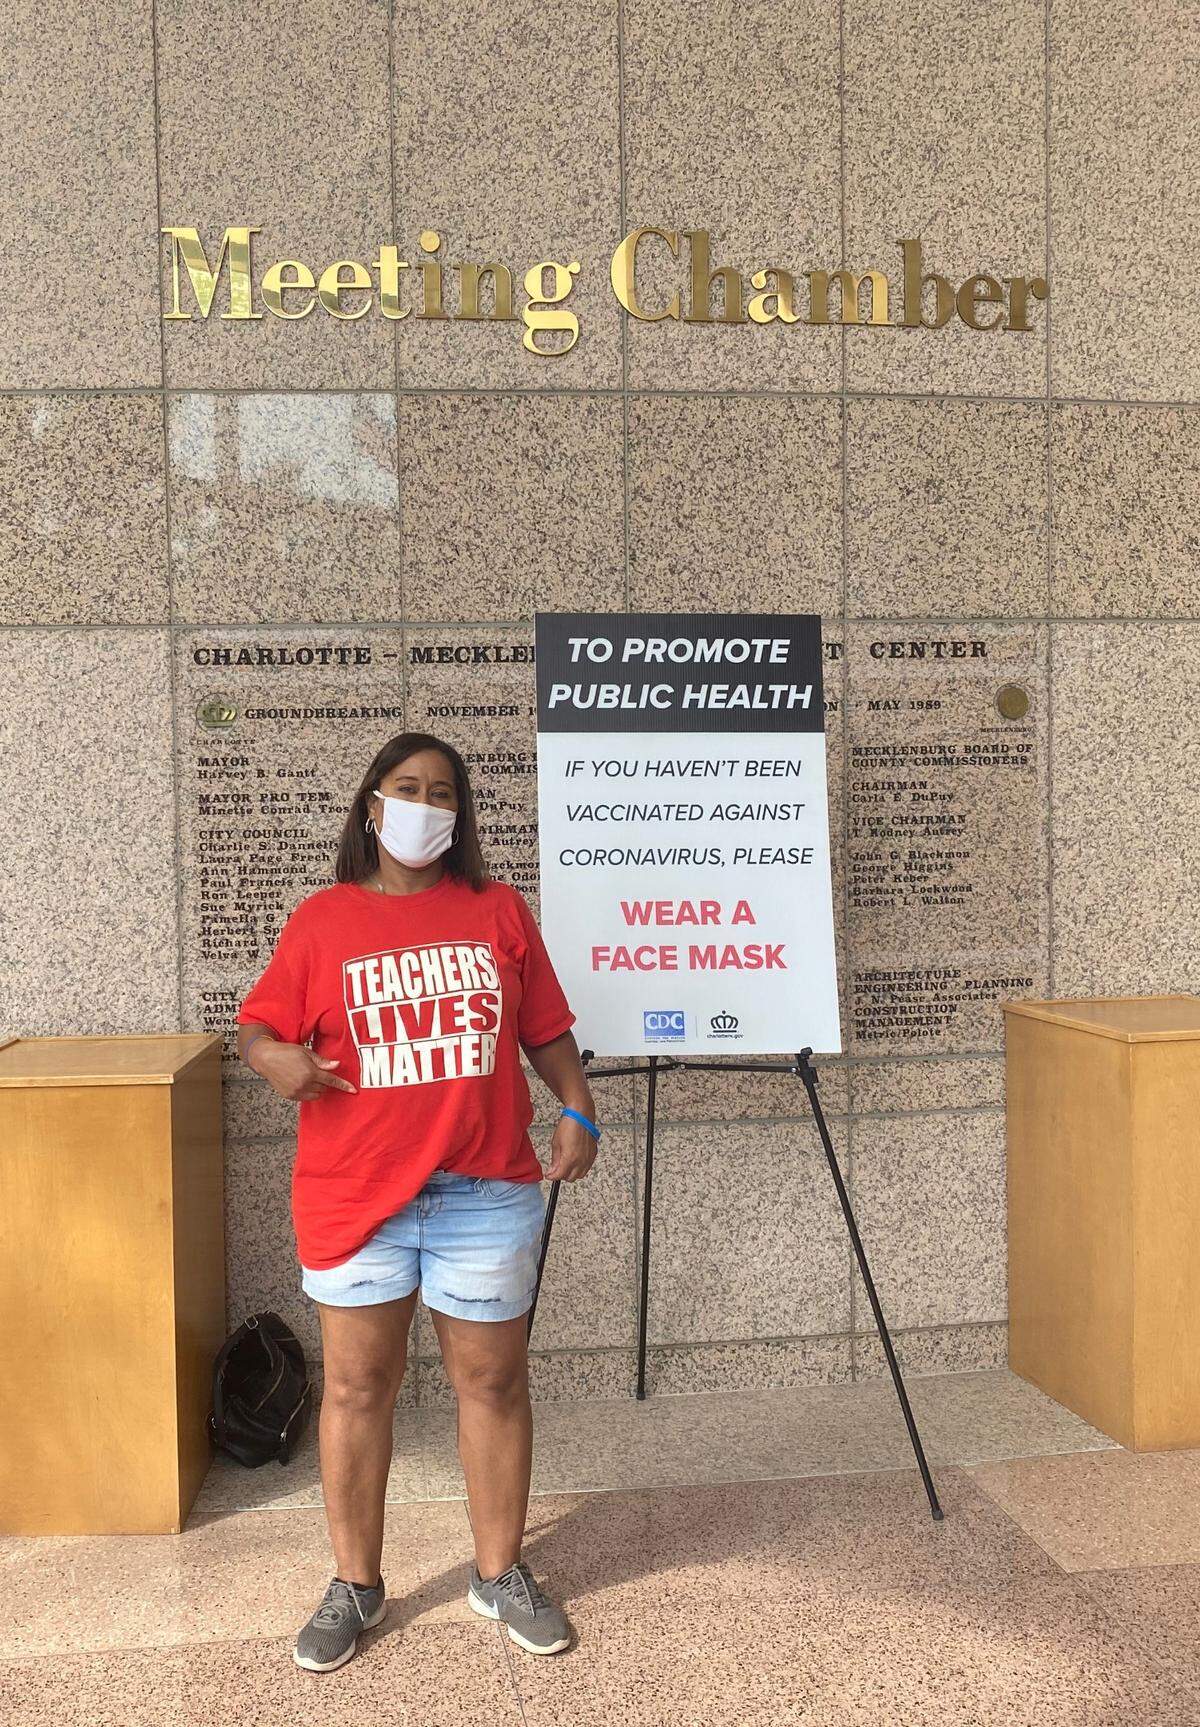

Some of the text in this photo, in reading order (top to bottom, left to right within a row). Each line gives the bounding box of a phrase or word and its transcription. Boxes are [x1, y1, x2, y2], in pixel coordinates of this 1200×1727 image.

[161, 226, 1049, 356] Meeting Chamber
[193, 646, 372, 666] CHARLOTTE
[869, 641, 989, 660] CENTER
[567, 637, 614, 663] TO
[621, 637, 791, 664] PROMOTE
[548, 683, 675, 709] PUBLIC
[681, 683, 813, 709] HEALTH
[244, 706, 403, 720] GROUNDBREAKING
[426, 705, 520, 718] NOVEMBER
[867, 700, 901, 711] MAY
[909, 700, 942, 711] 1989
[852, 743, 1034, 757] MECKLENBURG BOARD OF
[197, 757, 250, 767] MAYOR
[463, 752, 527, 763] ENBURG
[852, 755, 1028, 768] COUNTY COMMISSIONERS
[197, 768, 316, 780] Harvey B. Gantt
[481, 764, 538, 775] COMMIS
[564, 759, 802, 777] IF YOU HAVEN’T BEEN
[852, 781, 928, 792] CHAIRMAN
[198, 791, 331, 803] MAYOR PRO TEM
[852, 793, 886, 803] Carla
[911, 792, 955, 803] DuPuy
[198, 804, 351, 816] Minette Conrad Tros
[480, 801, 526, 812] DuPuy
[565, 803, 806, 822] VACCINATED AGAINST
[852, 815, 967, 827] VICE CHAIRMAN
[198, 828, 309, 840] CITY COUNCIL
[479, 824, 538, 835] AIRMAN
[870, 828, 916, 839] Rodney
[922, 826, 964, 838] Autrey
[199, 842, 251, 852] Charlie
[491, 837, 536, 848] Autrey
[198, 852, 330, 865] Laura Page Frech
[559, 847, 814, 867] CORONAVIRUS, PLEASE
[852, 851, 882, 862] John
[908, 850, 971, 860] Blackmon
[200, 865, 308, 876] Ann Hammond
[852, 861, 954, 874] George Higgins
[200, 878, 233, 888] Paul
[239, 878, 294, 888] Francis
[852, 875, 886, 884] Peter
[200, 890, 282, 901] Ron Leeper
[852, 883, 973, 897] Barbara Lockwood
[200, 901, 285, 913] Sue Myrick
[853, 897, 896, 908] Robert
[921, 895, 966, 906] Walton
[620, 900, 757, 926] WEAR A
[202, 926, 256, 937] Herbert
[202, 938, 258, 948] Richard
[201, 950, 238, 960] Velva
[591, 944, 788, 972] FACE MASK
[346, 946, 500, 1008] TEACHERS
[855, 969, 962, 982] ARCHITECTURE
[854, 977, 1034, 993] ENGINEERING PLANNING
[202, 991, 239, 1002] CITY
[932, 991, 999, 1003] Associates
[854, 1004, 958, 1017] CONSTRUCTION
[350, 992, 499, 1046] LIVES
[645, 1012, 684, 1030] CDC
[855, 1015, 951, 1028] MANAGEMENT
[360, 1032, 497, 1087] MATTER
